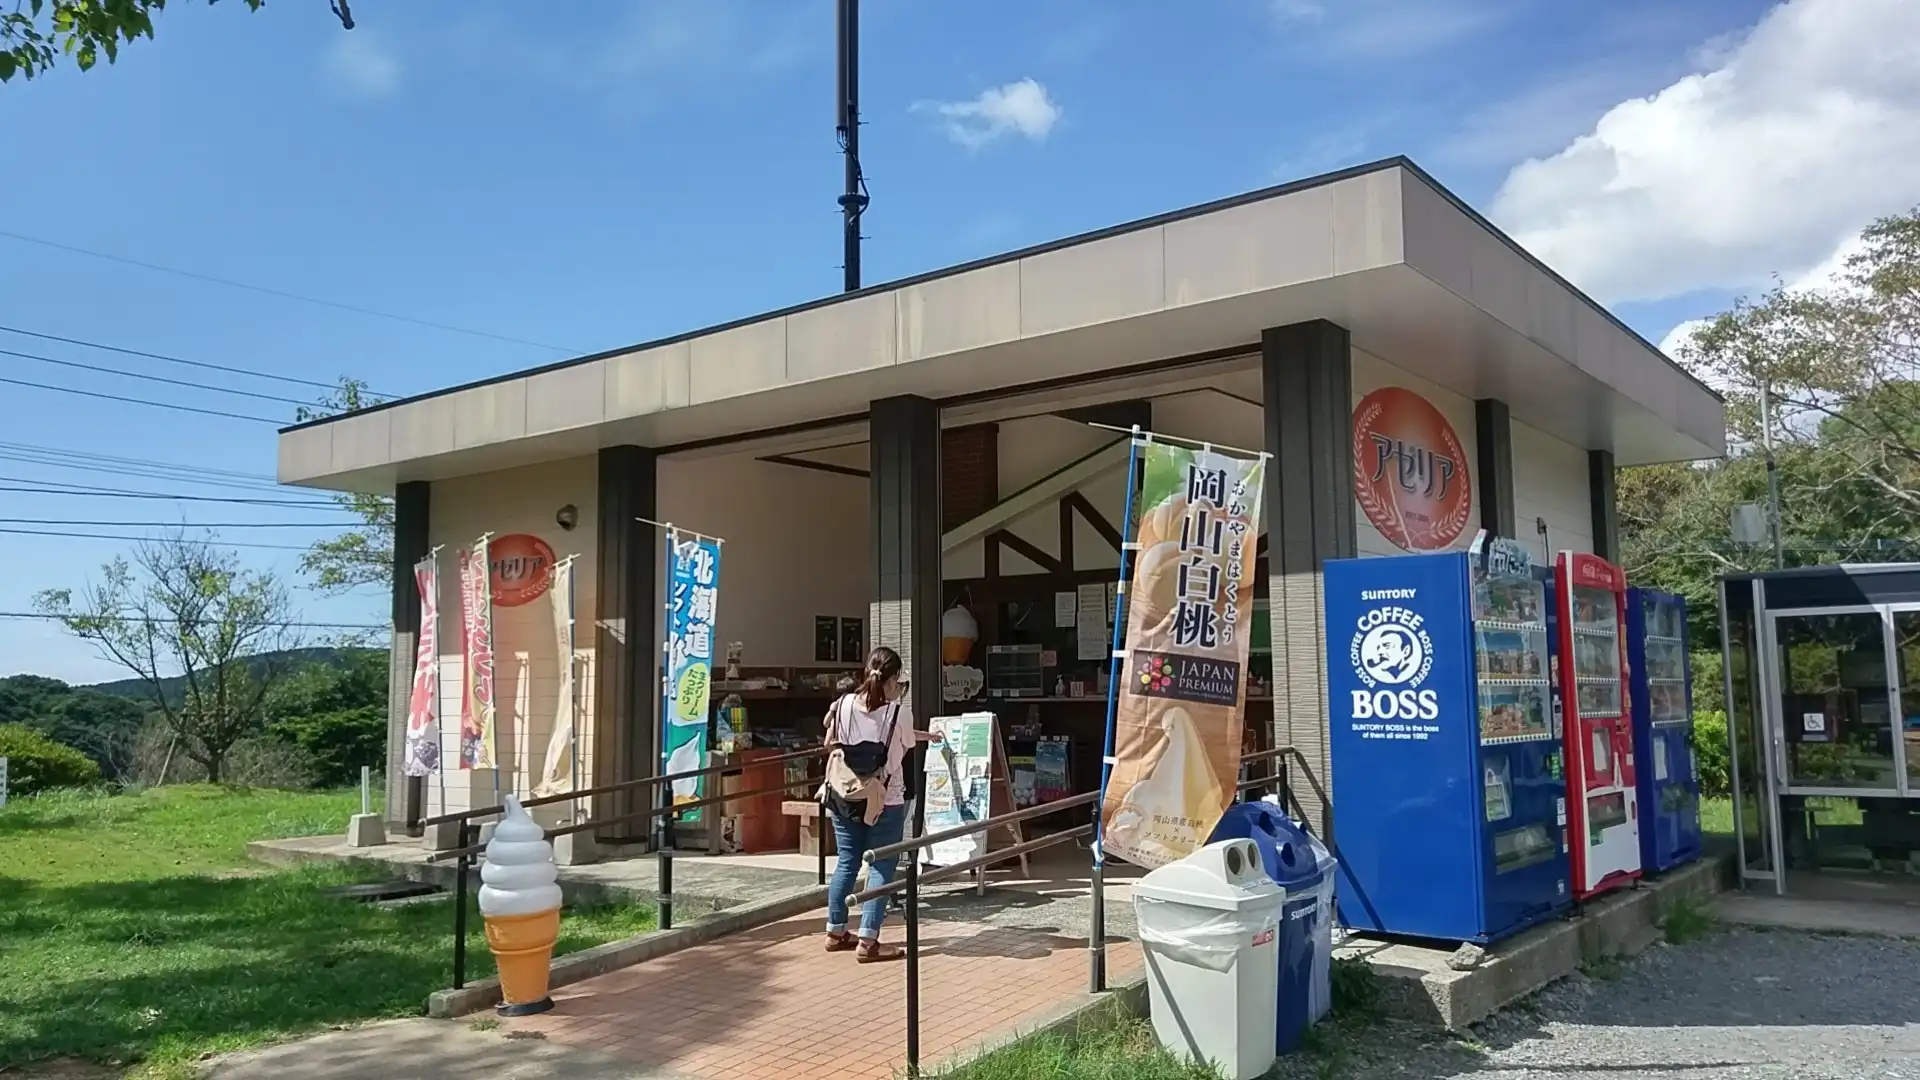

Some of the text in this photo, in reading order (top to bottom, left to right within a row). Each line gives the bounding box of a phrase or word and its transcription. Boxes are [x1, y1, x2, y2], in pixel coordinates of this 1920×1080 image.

[1170, 464, 1227, 649] 岡山白桃
[1223, 479, 1246, 643] おかやまはくとう
[686, 549, 717, 658] 北海道
[1361, 588, 1417, 601] SUNTORY
[1357, 606, 1424, 631] COFFEE
[1181, 660, 1234, 681] JAPAN
[1350, 631, 1377, 689] BOSS COFFEE
[1409, 629, 1434, 689] BOSS COFFEE
[1178, 677, 1233, 694] PREMIUM
[1350, 689, 1439, 720] BOSS
[1351, 723, 1384, 731] SUNTORY
[1385, 724, 1405, 732] BOSS
